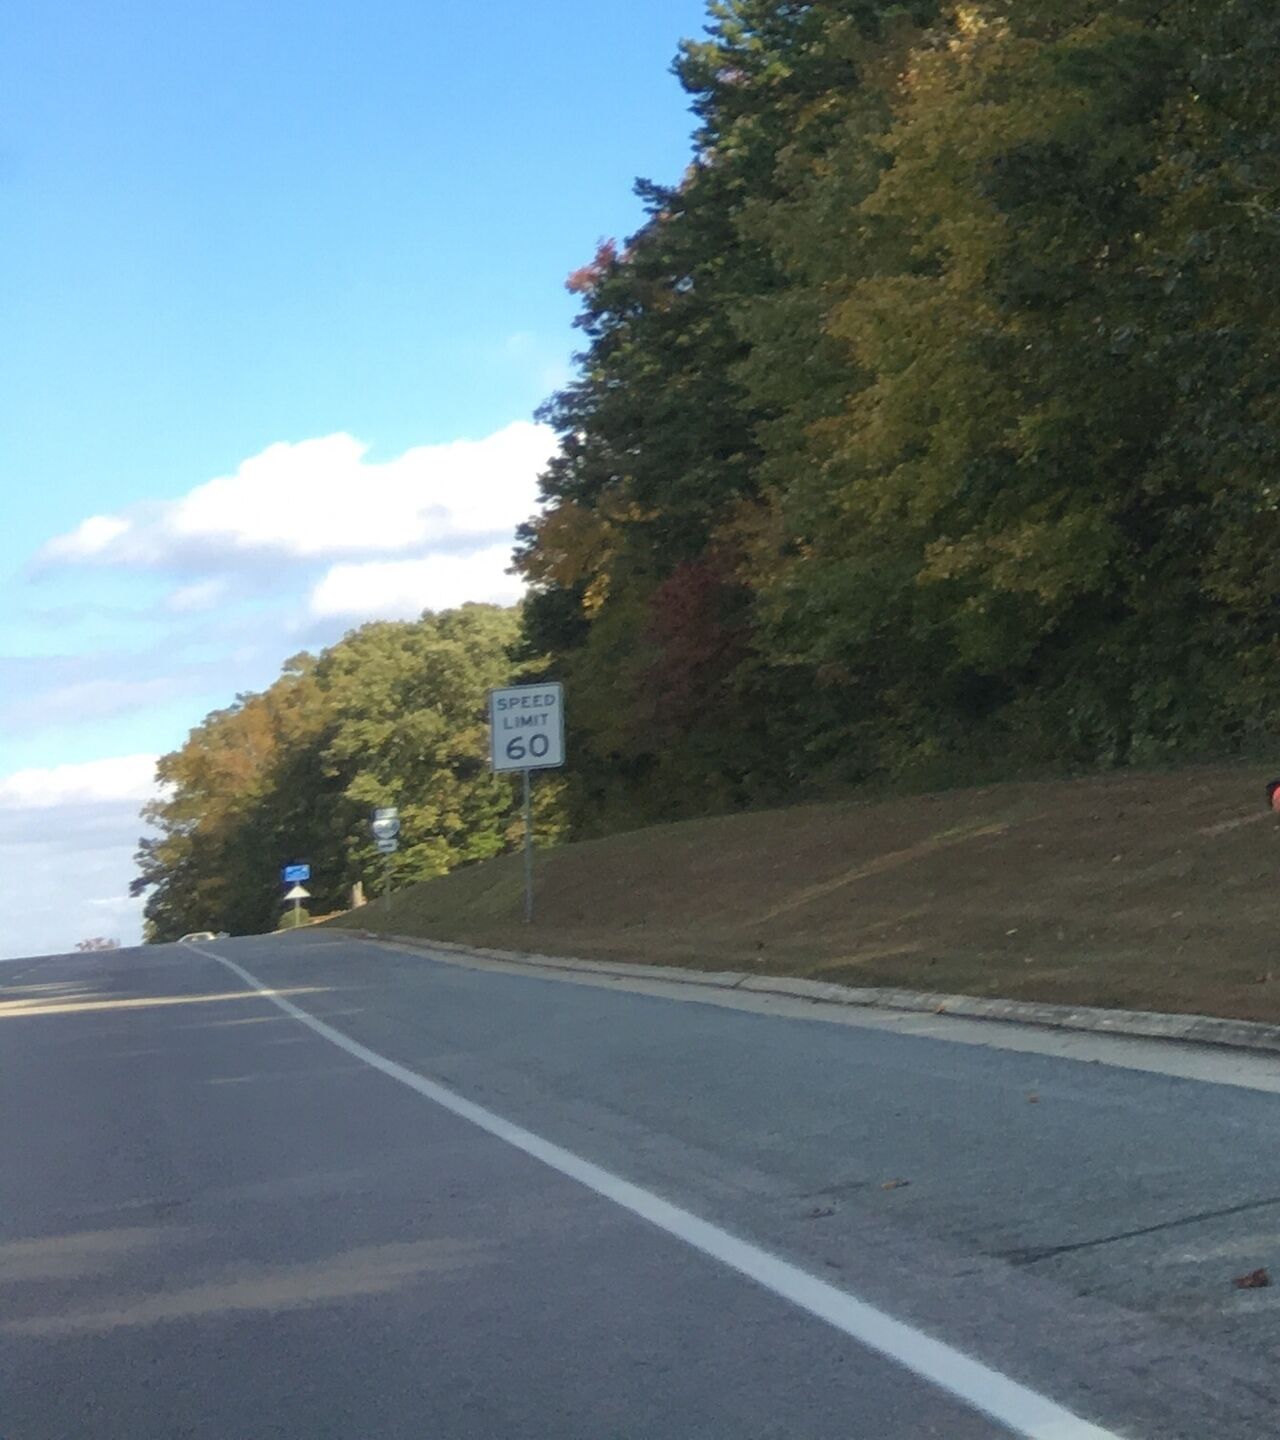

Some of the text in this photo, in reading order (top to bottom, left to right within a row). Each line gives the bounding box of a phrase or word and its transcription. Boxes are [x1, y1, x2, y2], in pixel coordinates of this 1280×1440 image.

[497, 694, 556, 711] SPEED
[503, 714, 549, 730] LIMIT
[506, 734, 549, 760] 60
